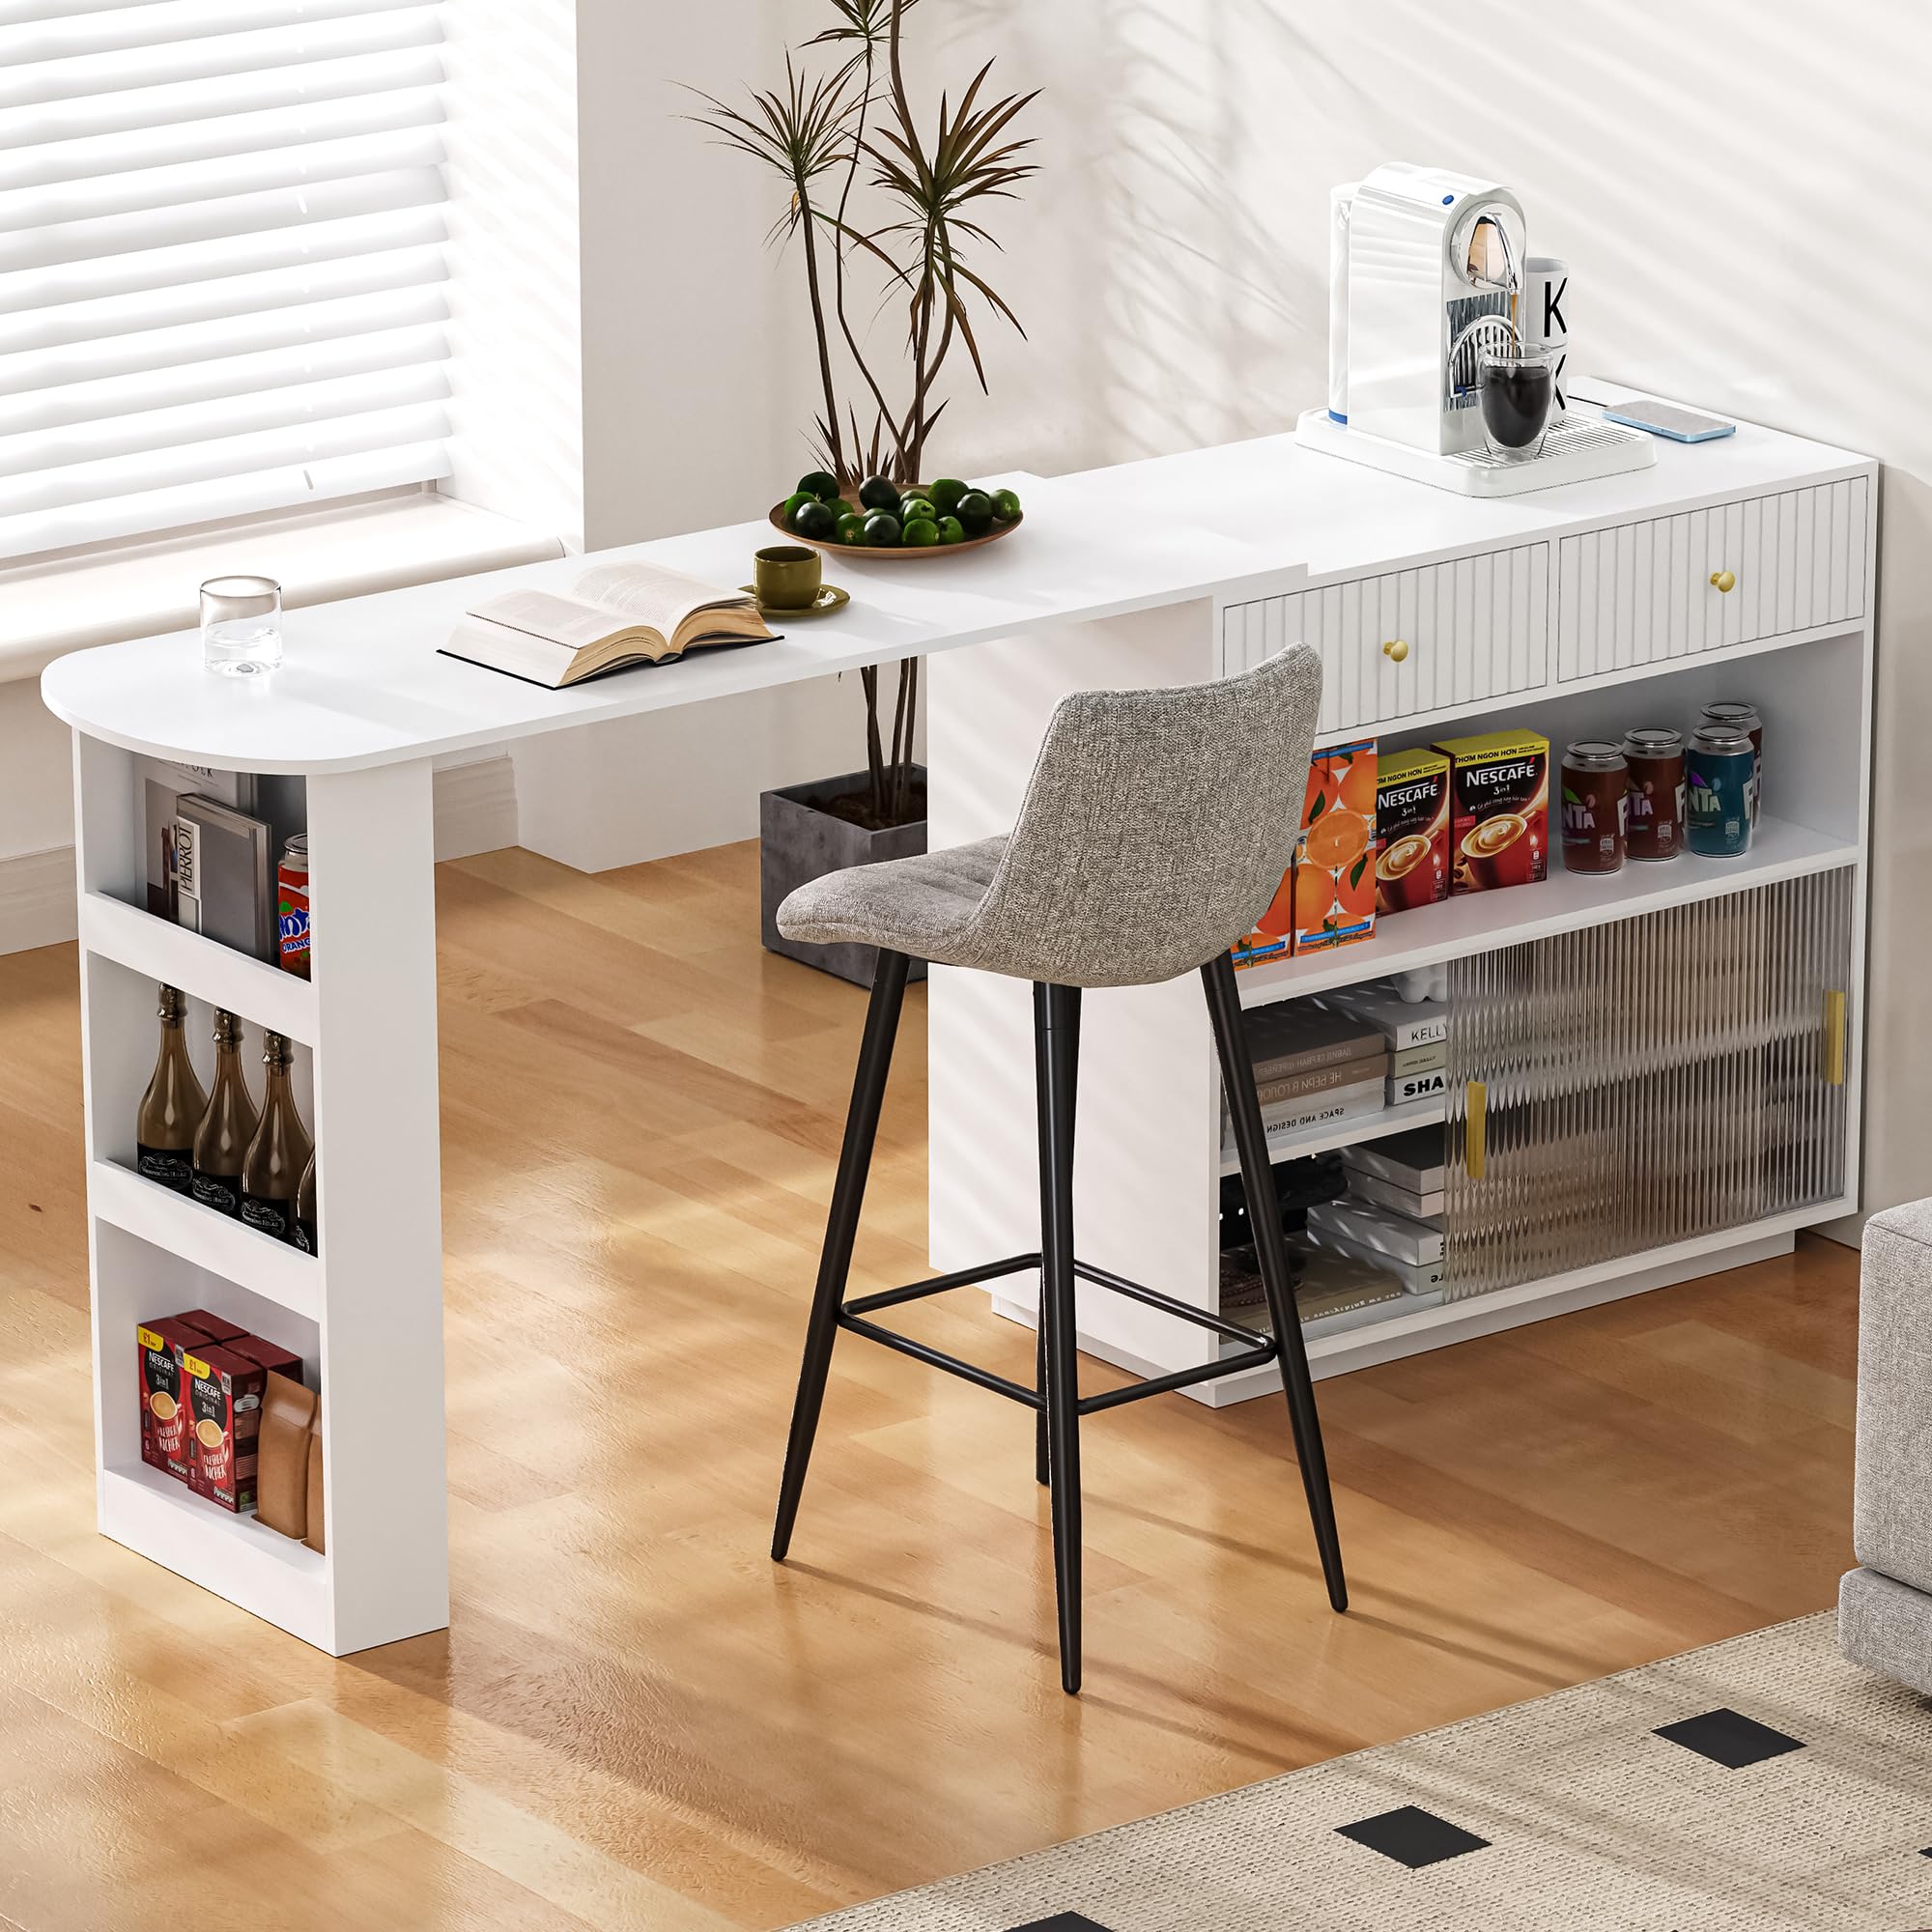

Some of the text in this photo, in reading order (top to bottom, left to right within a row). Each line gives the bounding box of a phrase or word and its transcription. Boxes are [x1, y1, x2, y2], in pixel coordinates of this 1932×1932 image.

[1544, 277, 1567, 337] K
[1466, 756, 1536, 787] NESCAFÉ
[1477, 751, 1499, 760] NGON
[1378, 776, 1438, 810] NESCAFÉ
[179, 822, 192, 892] PIERROT
[1404, 1076, 1444, 1096] SHA
